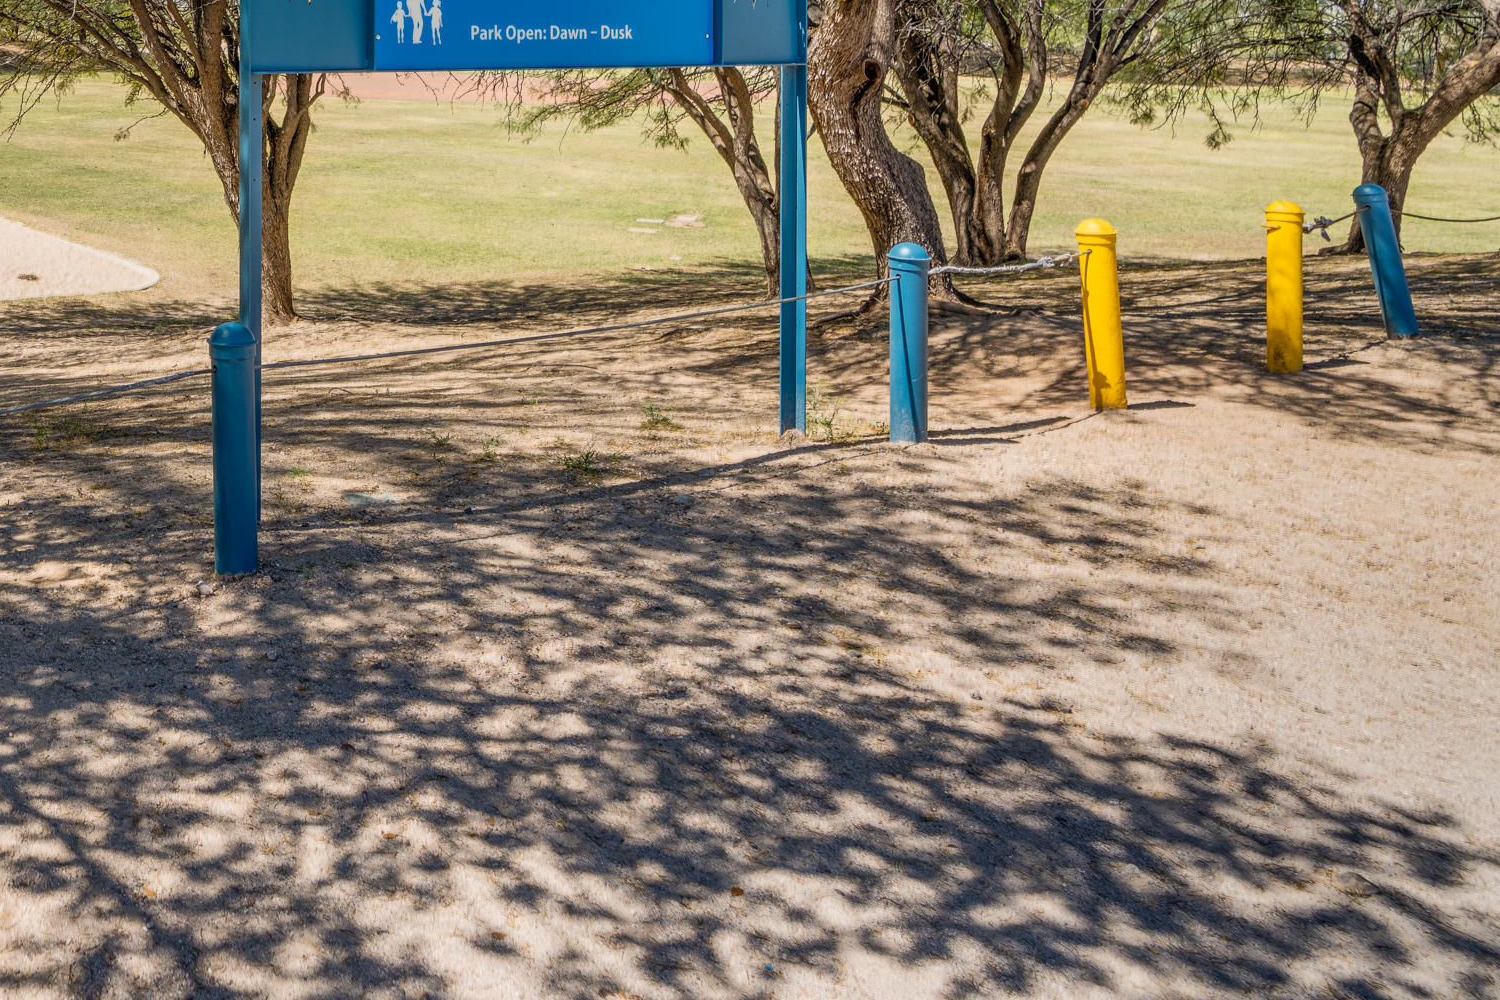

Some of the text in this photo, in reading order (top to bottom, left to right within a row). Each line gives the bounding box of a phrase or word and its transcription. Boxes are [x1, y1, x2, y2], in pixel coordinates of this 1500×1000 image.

[471, 25, 502, 40] Park
[506, 25, 546, 43] Open:
[550, 25, 587, 39] Dawn
[601, 25, 632, 39] Dusk
